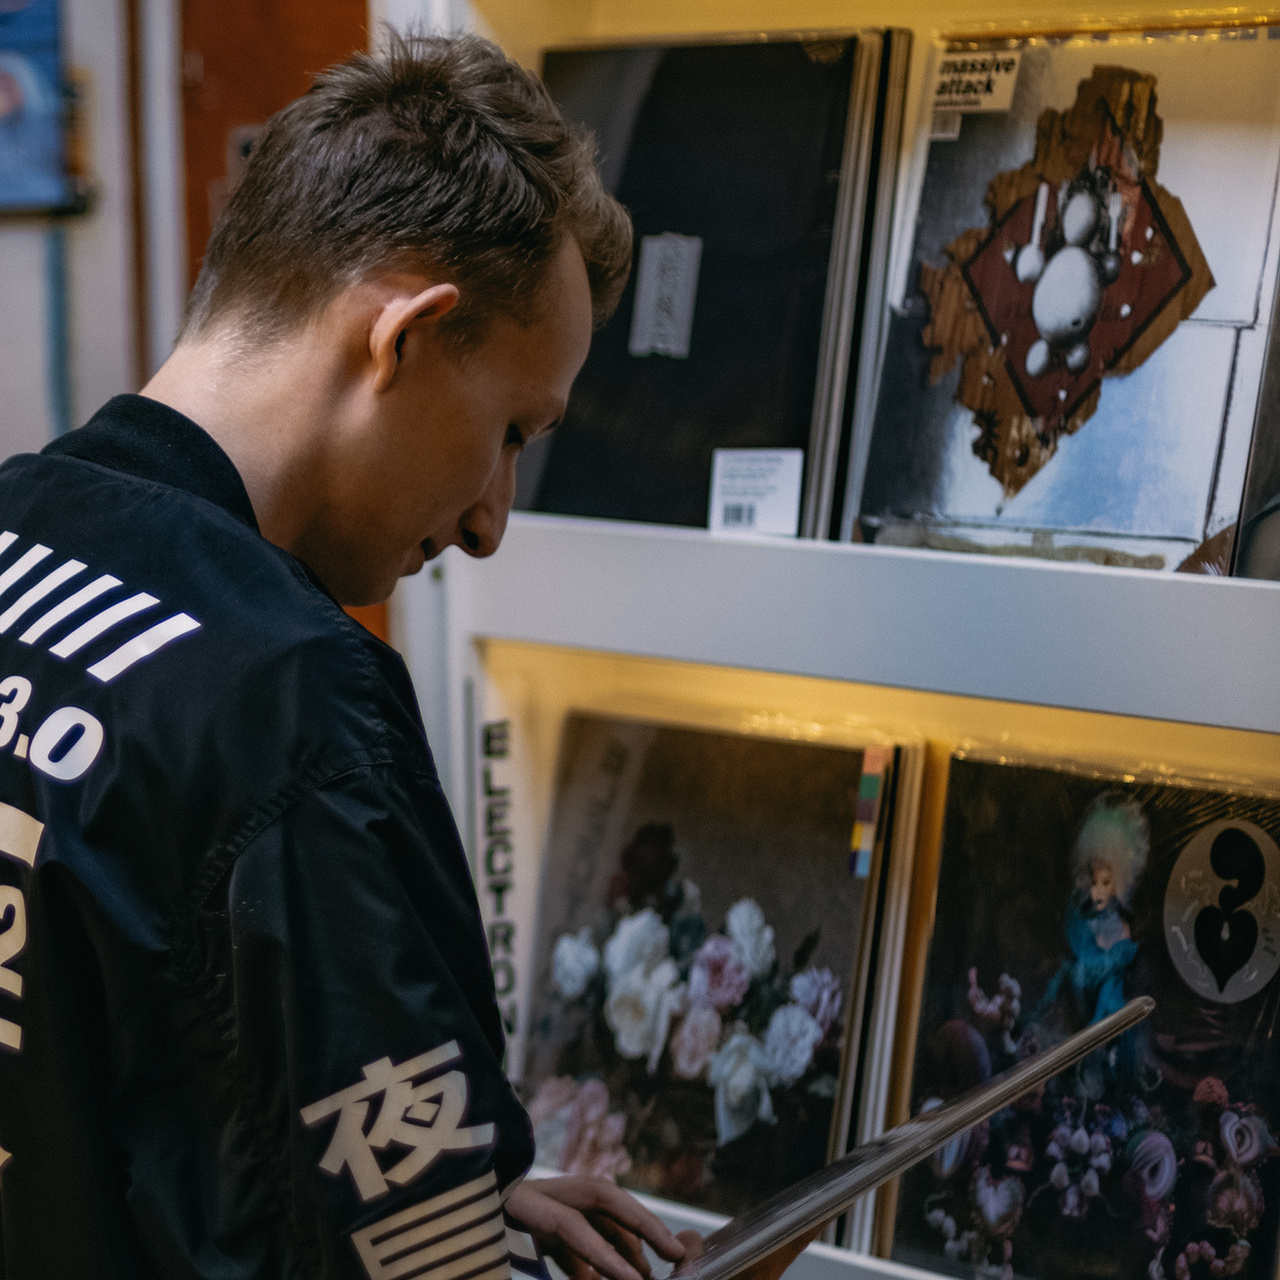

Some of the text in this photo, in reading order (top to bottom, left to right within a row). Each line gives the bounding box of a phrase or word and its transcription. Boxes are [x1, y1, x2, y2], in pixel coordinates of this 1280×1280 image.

[936, 76, 993, 96] attack
[940, 53, 1016, 74] massive
[482, 720, 518, 1038] ELECTRON
[300, 1039, 494, 1202] 夜
